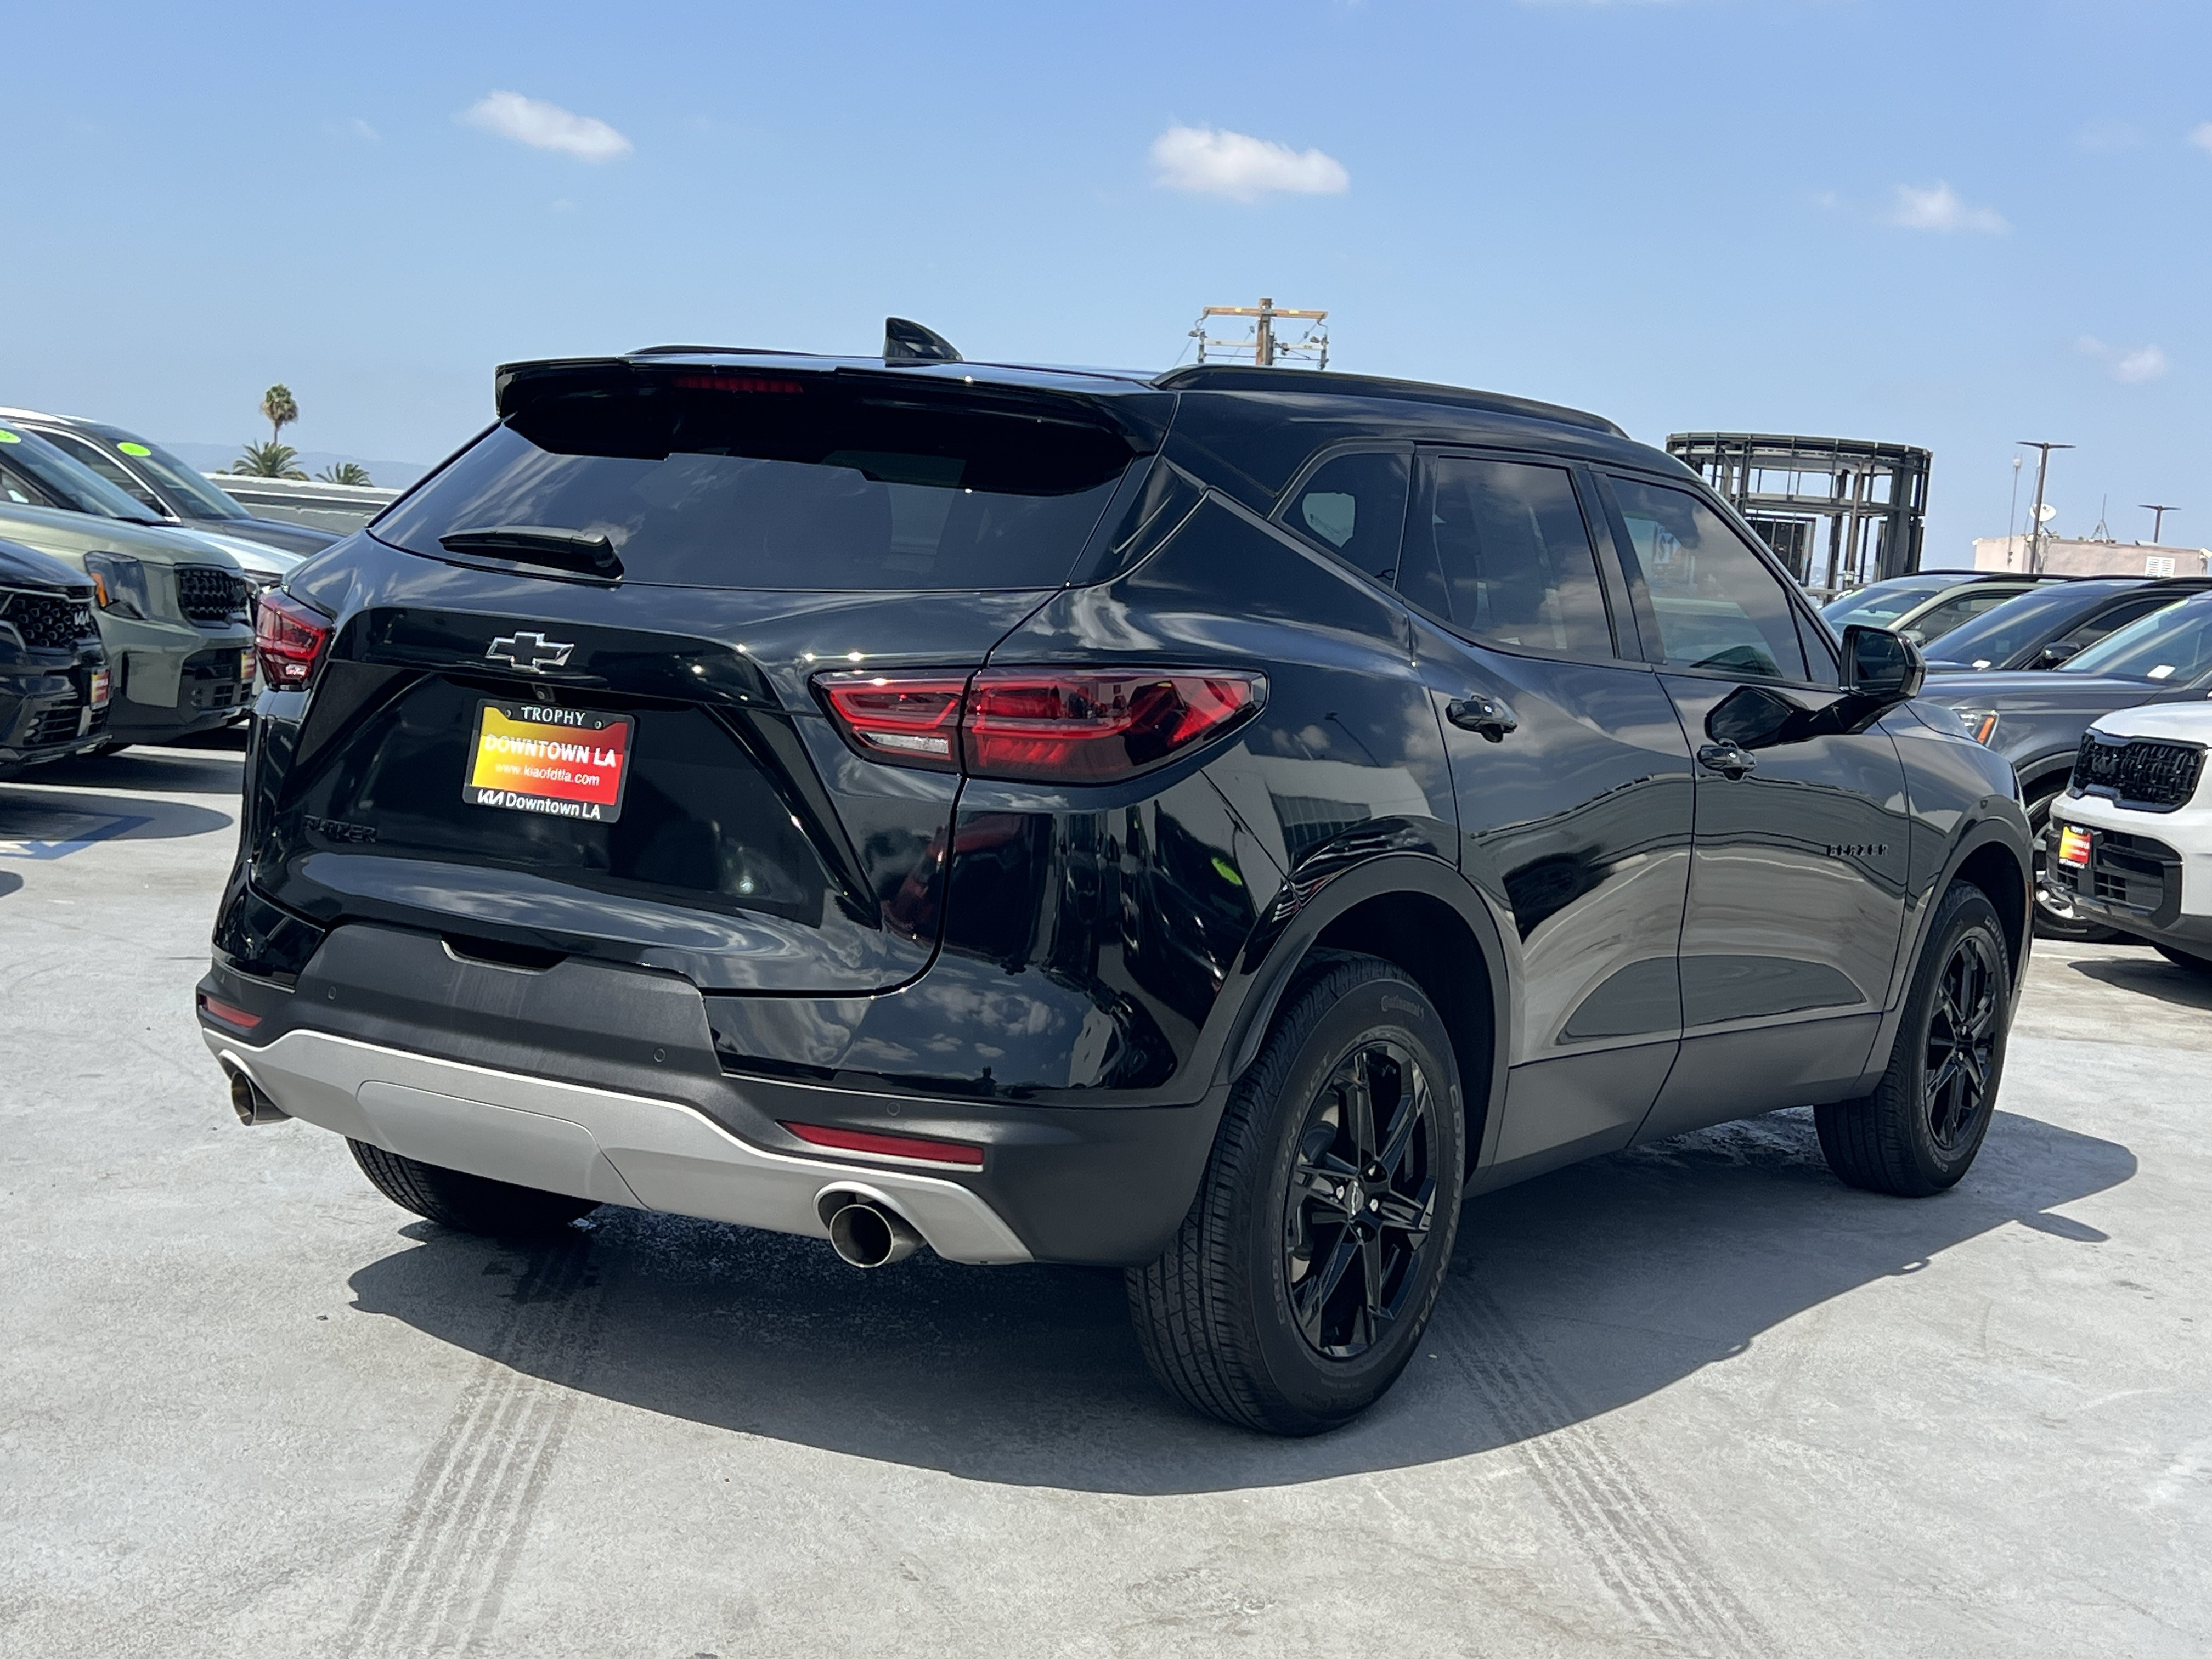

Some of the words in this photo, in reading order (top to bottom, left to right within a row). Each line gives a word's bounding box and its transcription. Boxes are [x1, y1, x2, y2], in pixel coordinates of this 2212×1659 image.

[521, 706, 586, 726] TROPHY
[484, 733, 590, 764] DOWNTOWN
[593, 747, 616, 768] LA
[494, 762, 600, 786] www.kiaofdtla.com
[506, 793, 579, 816] Downtown
[582, 802, 601, 820] LA
